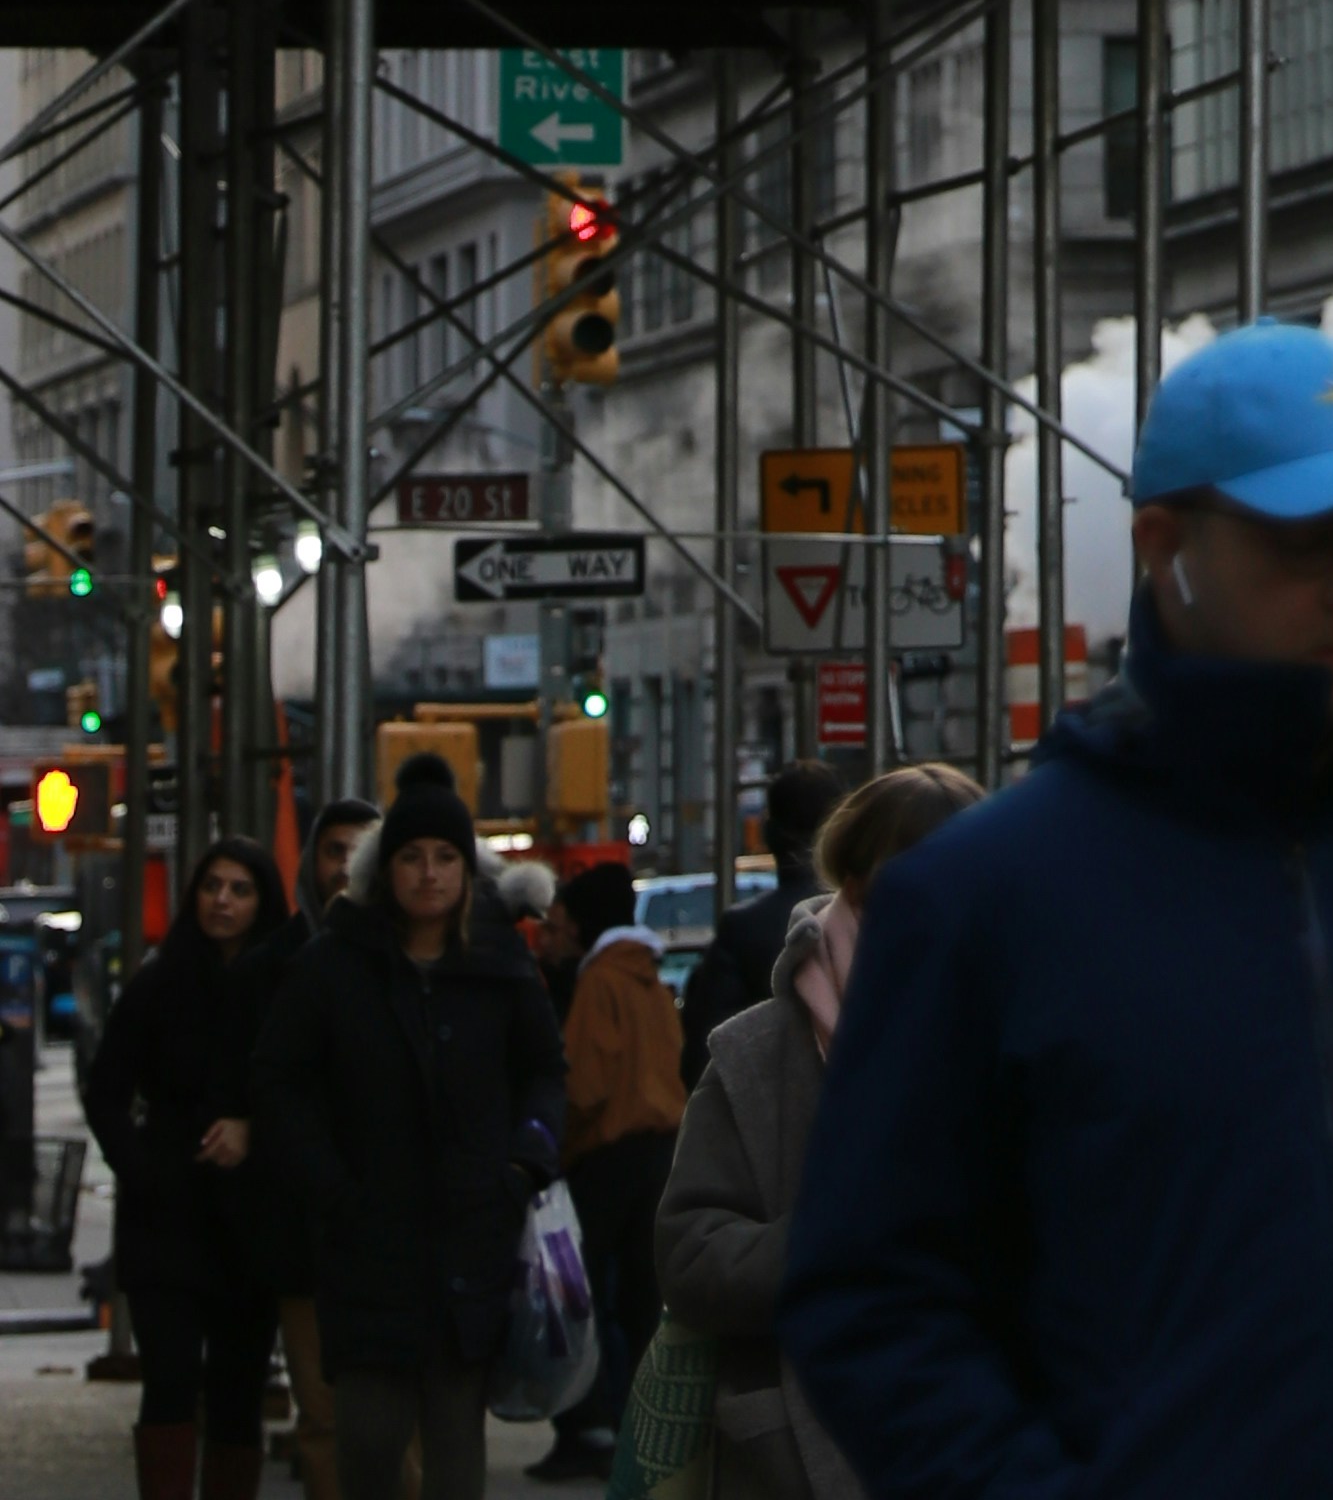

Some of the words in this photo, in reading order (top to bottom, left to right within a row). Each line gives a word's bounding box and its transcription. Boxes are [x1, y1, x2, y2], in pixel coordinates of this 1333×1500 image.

[514, 75, 611, 100] Rive
[411, 487, 424, 519] E
[437, 486, 472, 520] 20
[484, 485, 513, 518] St
[478, 554, 536, 583] ONE
[566, 551, 629, 578] WAY
